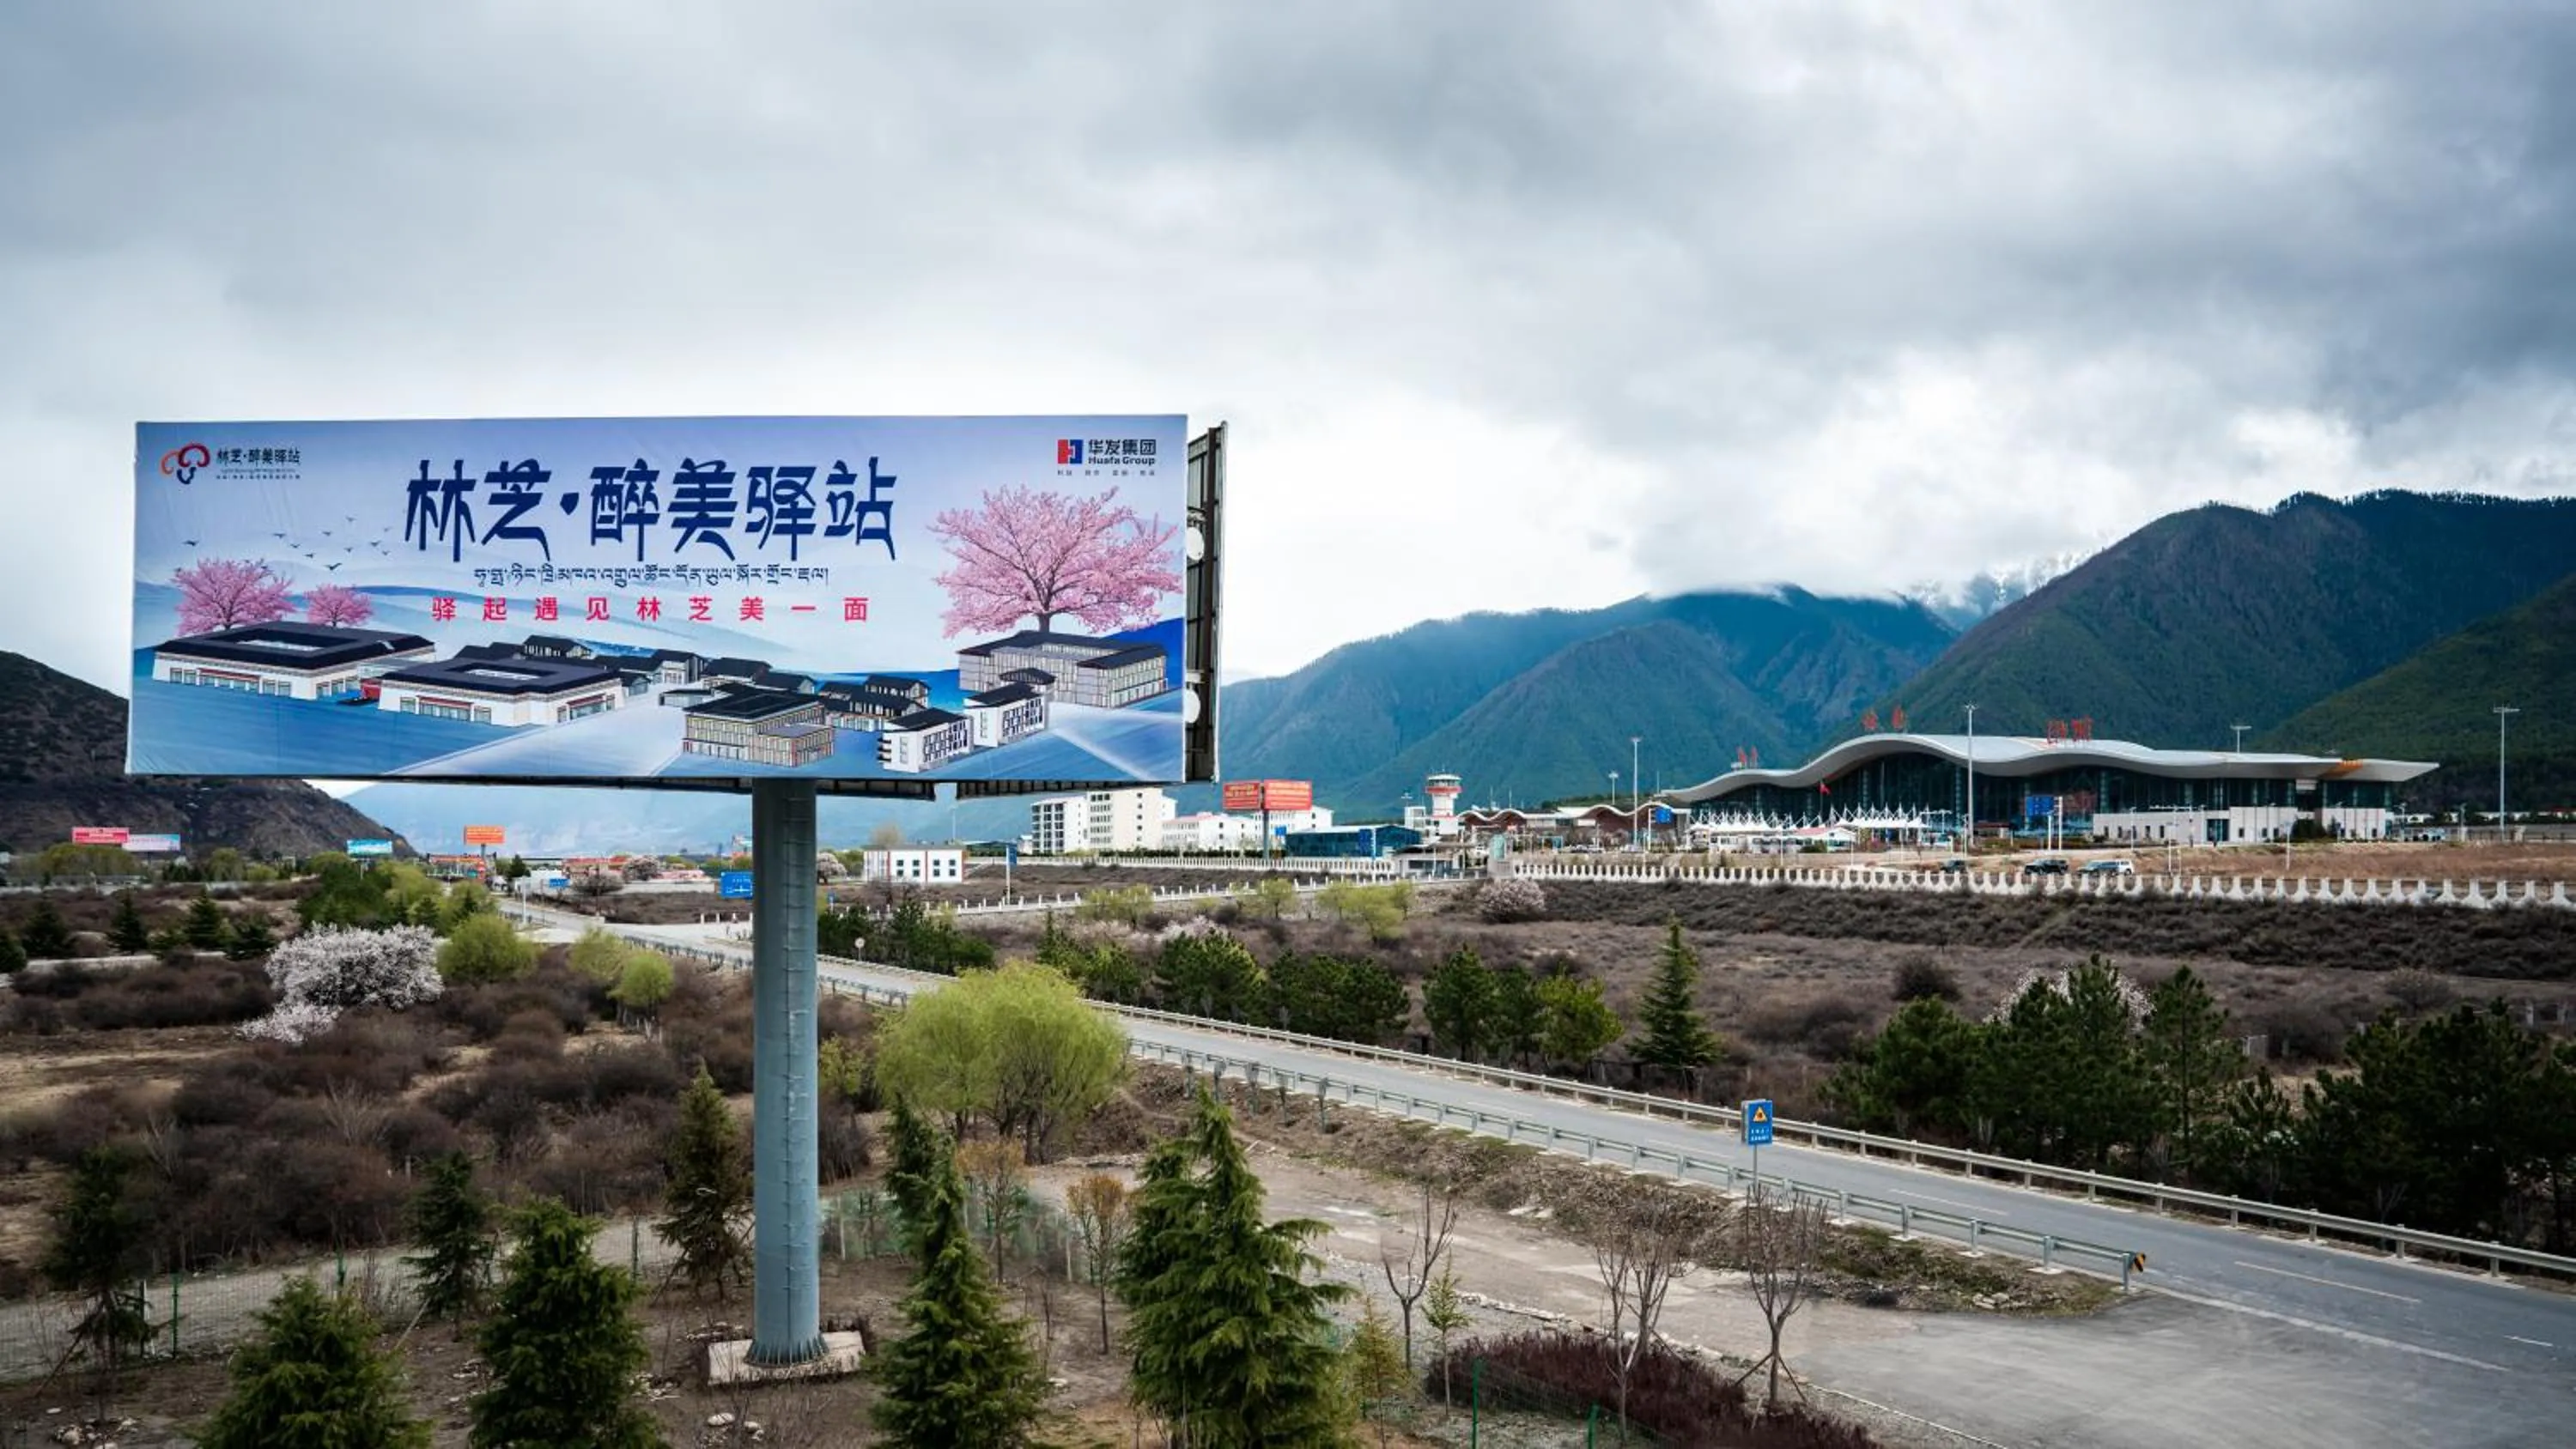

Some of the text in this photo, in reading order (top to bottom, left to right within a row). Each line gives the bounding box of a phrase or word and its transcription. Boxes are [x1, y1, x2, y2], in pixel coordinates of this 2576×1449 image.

[1088, 439, 1157, 456] 华发集团
[1088, 456, 1156, 466] Huafa Group
[432, 597, 868, 621] 驿起遇见林芝美一面
